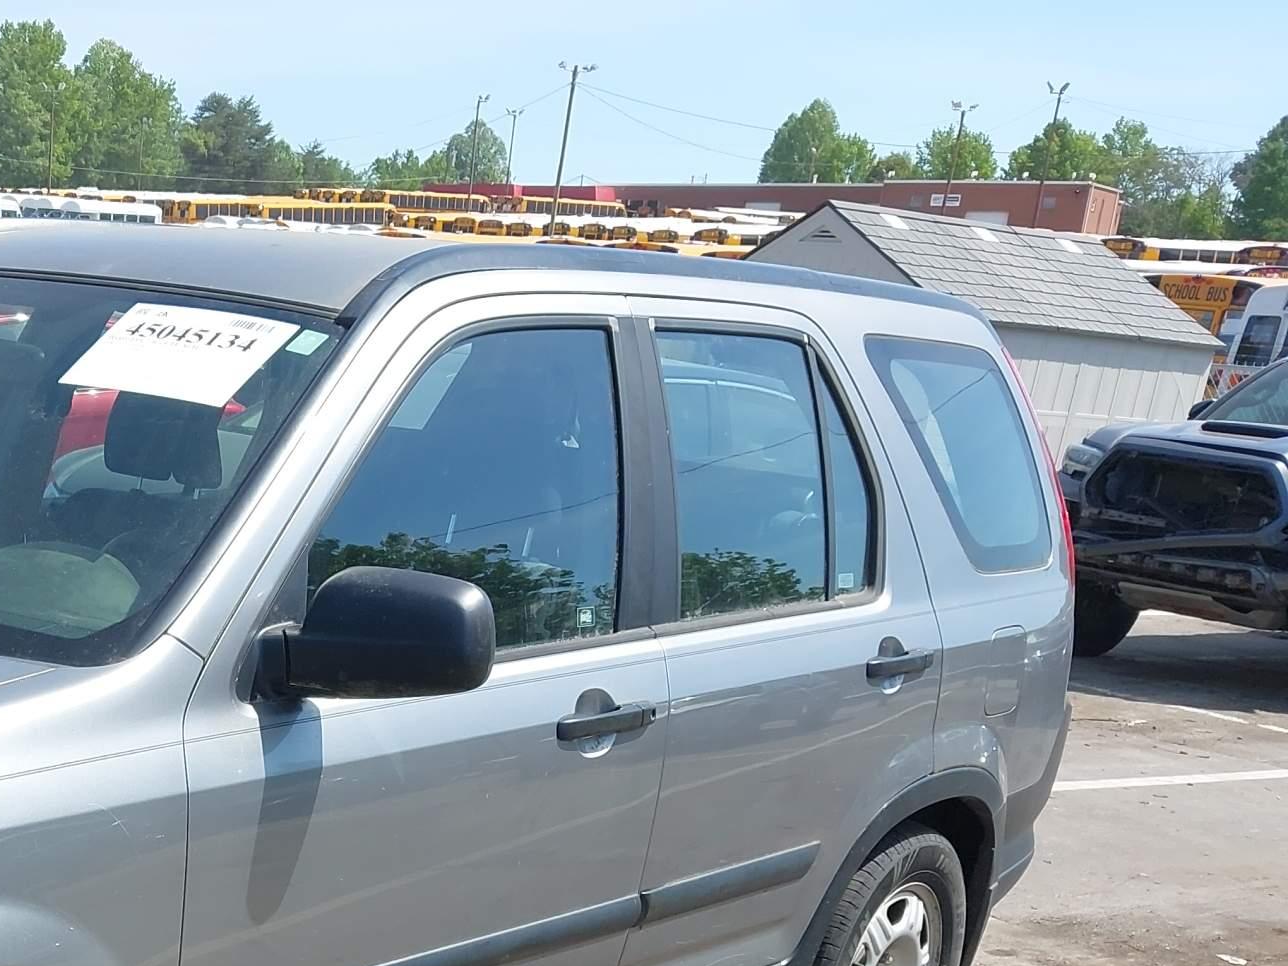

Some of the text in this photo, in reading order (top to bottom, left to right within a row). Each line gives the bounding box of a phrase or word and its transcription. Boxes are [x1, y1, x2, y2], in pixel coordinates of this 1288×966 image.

[1163, 282, 1230, 303] SCHOOL BUS
[125, 321, 258, 352] 45045134
